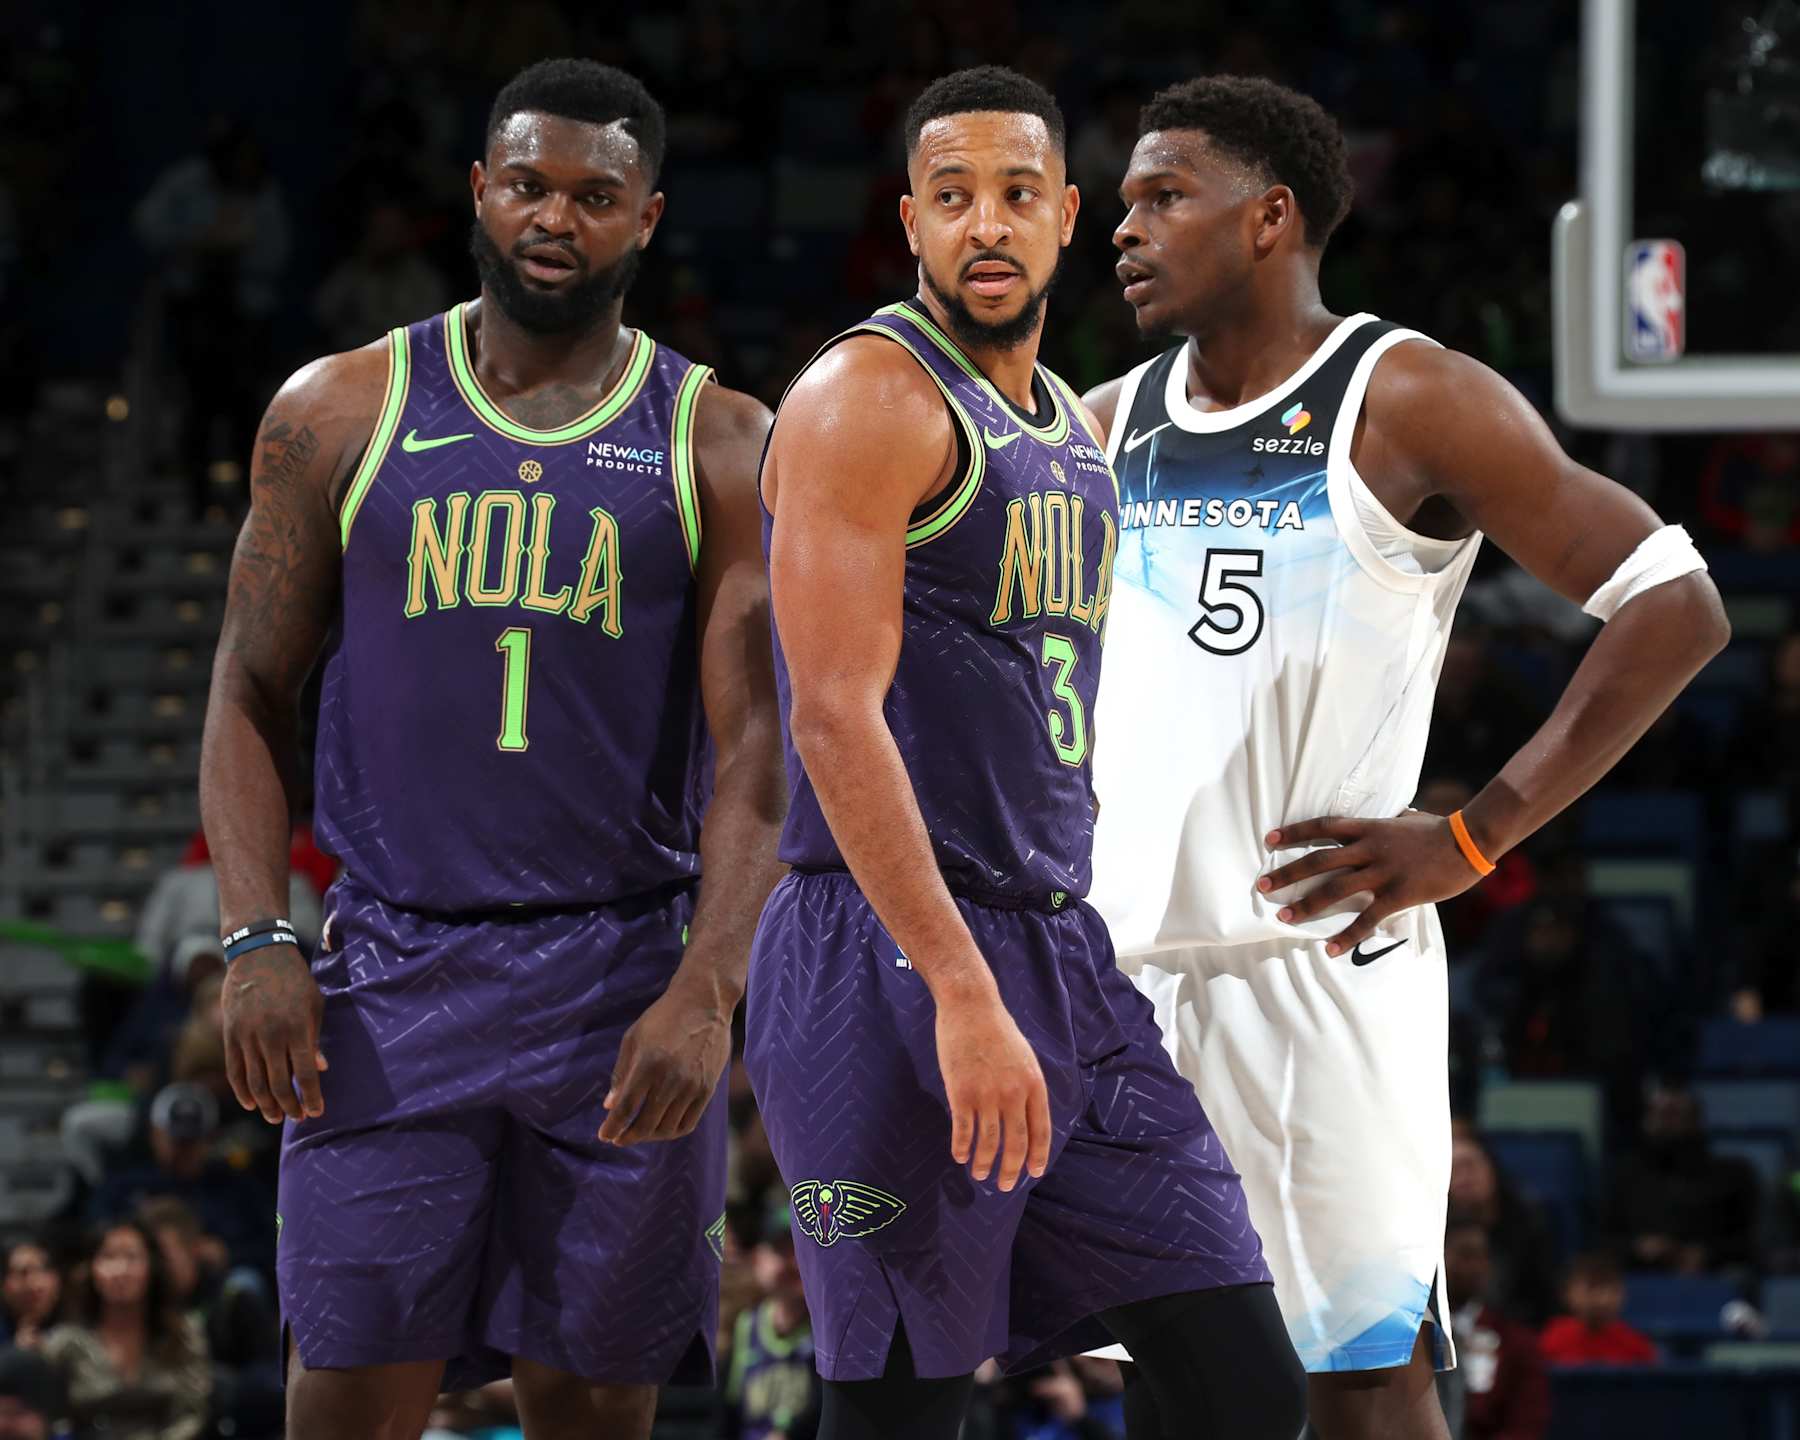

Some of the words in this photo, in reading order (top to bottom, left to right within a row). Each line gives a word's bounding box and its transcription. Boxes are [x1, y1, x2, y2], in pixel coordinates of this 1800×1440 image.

[586, 457, 662, 476] PRODUCTS
[588, 441, 664, 465] NEWAGE
[1252, 435, 1325, 456] sezzle
[404, 490, 623, 639] NOLA
[1118, 498, 1305, 531] INNESOTA
[989, 490, 1117, 649] NOLA
[1187, 548, 1265, 657] 5
[495, 626, 532, 752] 1
[1041, 632, 1089, 768] 3
